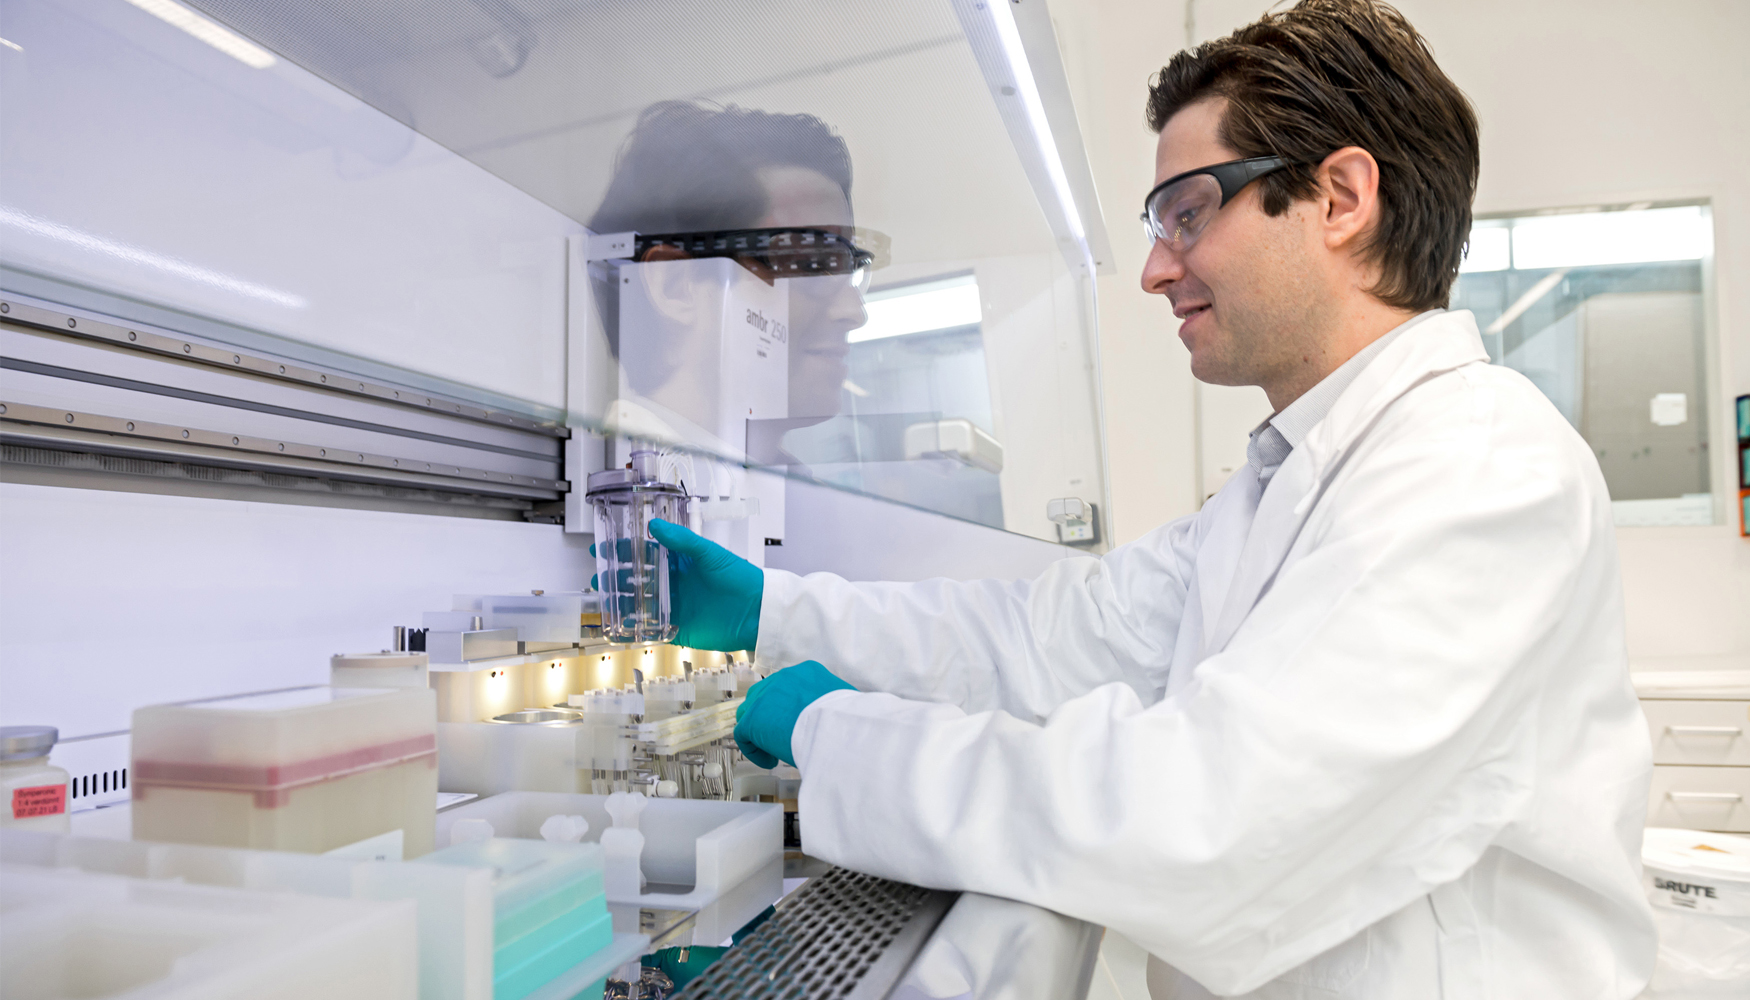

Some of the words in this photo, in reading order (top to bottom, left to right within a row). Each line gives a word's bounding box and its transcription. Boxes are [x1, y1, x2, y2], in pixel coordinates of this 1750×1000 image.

[746, 308, 768, 333] ambr
[771, 319, 787, 344] 250
[1654, 877, 1719, 900] BRUTE
